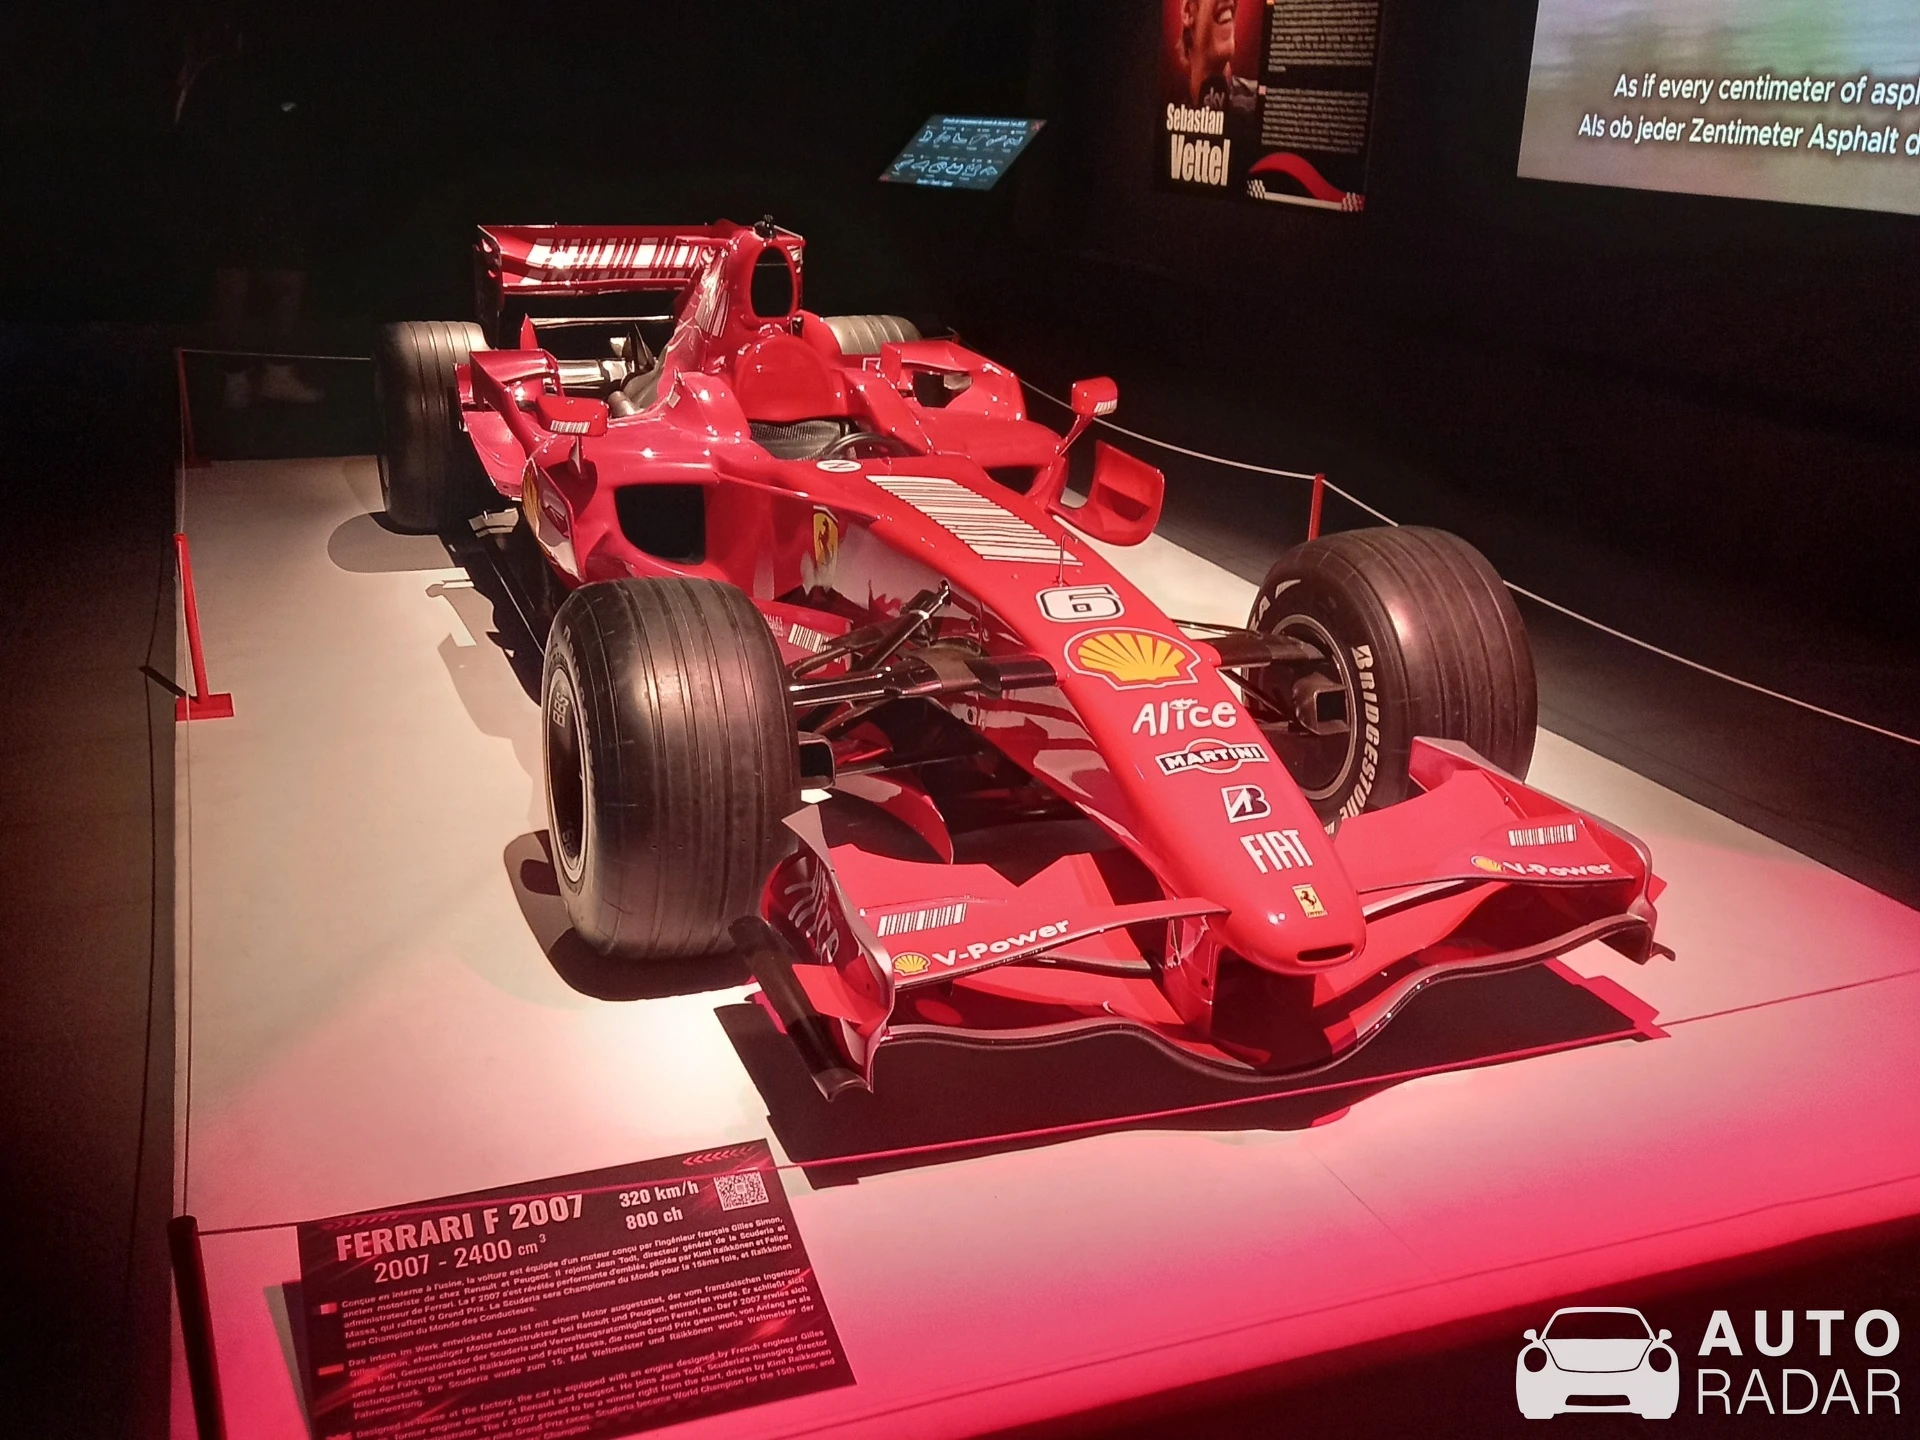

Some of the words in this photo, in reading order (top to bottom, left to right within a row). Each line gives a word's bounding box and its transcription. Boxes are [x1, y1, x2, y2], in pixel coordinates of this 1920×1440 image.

[1613, 74, 1637, 97] As
[1642, 74, 1656, 97] if
[1658, 79, 1714, 104] every
[1718, 75, 1835, 103] centimeter
[1840, 76, 1868, 104] of
[1166, 102, 1224, 135] Sebastian
[1579, 113, 1605, 137] Als
[1609, 117, 1633, 139] ob
[1634, 115, 1686, 144] jeder
[1689, 117, 1804, 147] Zentimeter
[1807, 123, 1900, 156] Asphalt
[1171, 133, 1231, 186] Vettel
[1037, 584, 1124, 622] 6
[553, 691, 570, 728] BBS
[1131, 698, 1237, 737] Alice
[1166, 746, 1262, 771] MARTINI
[1240, 829, 1313, 874] FIAT
[1503, 860, 1613, 877] V-Power
[932, 919, 1069, 968] V-Power
[619, 1188, 650, 1208] 320
[654, 1180, 699, 1201] km/h
[336, 1213, 474, 1261] FERRARI
[483, 1208, 500, 1234] F
[509, 1194, 583, 1230] 2007
[625, 1210, 658, 1230] 800
[663, 1206, 683, 1223] ch
[374, 1254, 429, 1283] 2007
[454, 1239, 512, 1268] 2400
